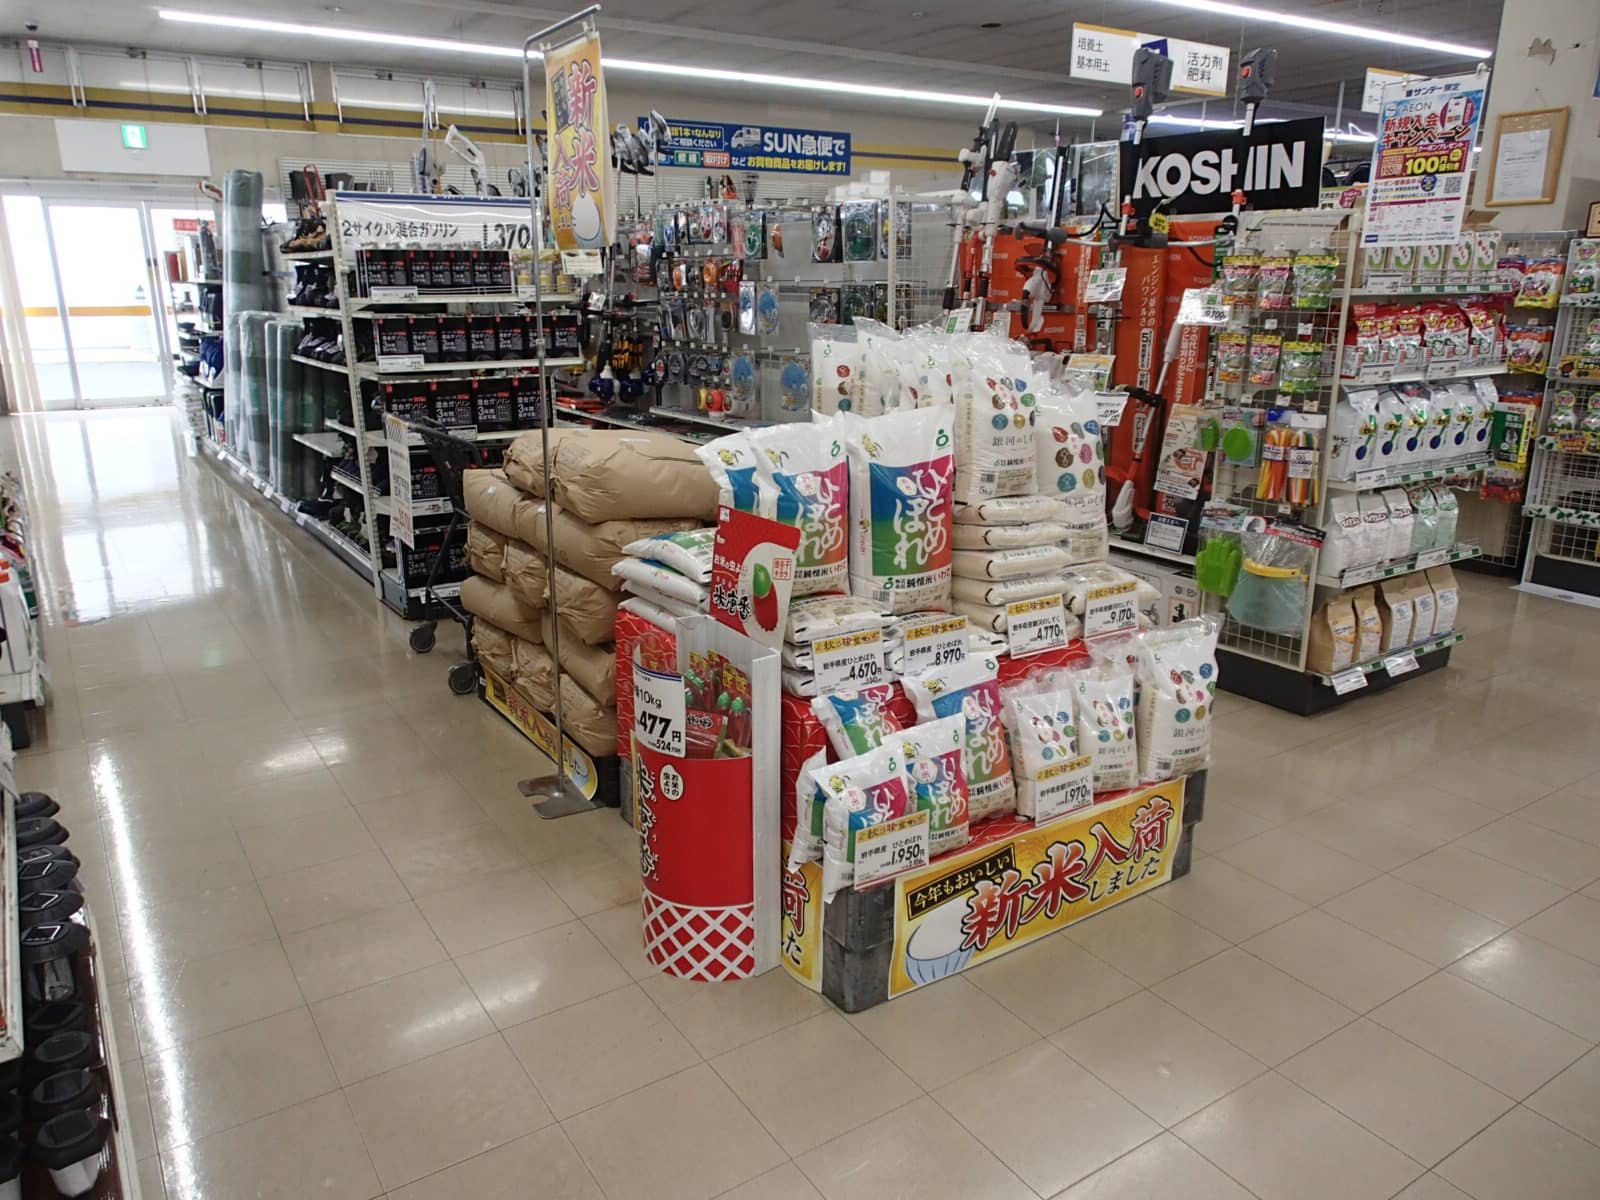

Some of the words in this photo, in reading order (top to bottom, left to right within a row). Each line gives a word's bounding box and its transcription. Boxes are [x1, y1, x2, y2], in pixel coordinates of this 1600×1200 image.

[1078, 37, 1104, 53] 培養土
[1076, 55, 1111, 73] 基本用土
[1186, 51, 1223, 71] 活力剤
[1186, 67, 1212, 83] 肥料
[568, 59, 599, 194] 新米
[1384, 112, 1440, 132] 新規入会
[763, 131, 847, 157] SUN急便で
[1383, 126, 1472, 148] キャンペーン
[1132, 140, 1306, 200] KOSHIN
[914, 855, 1012, 909] 今年もおいしい
[960, 797, 1174, 951] 新米入荷
[1089, 855, 1159, 902] しました
